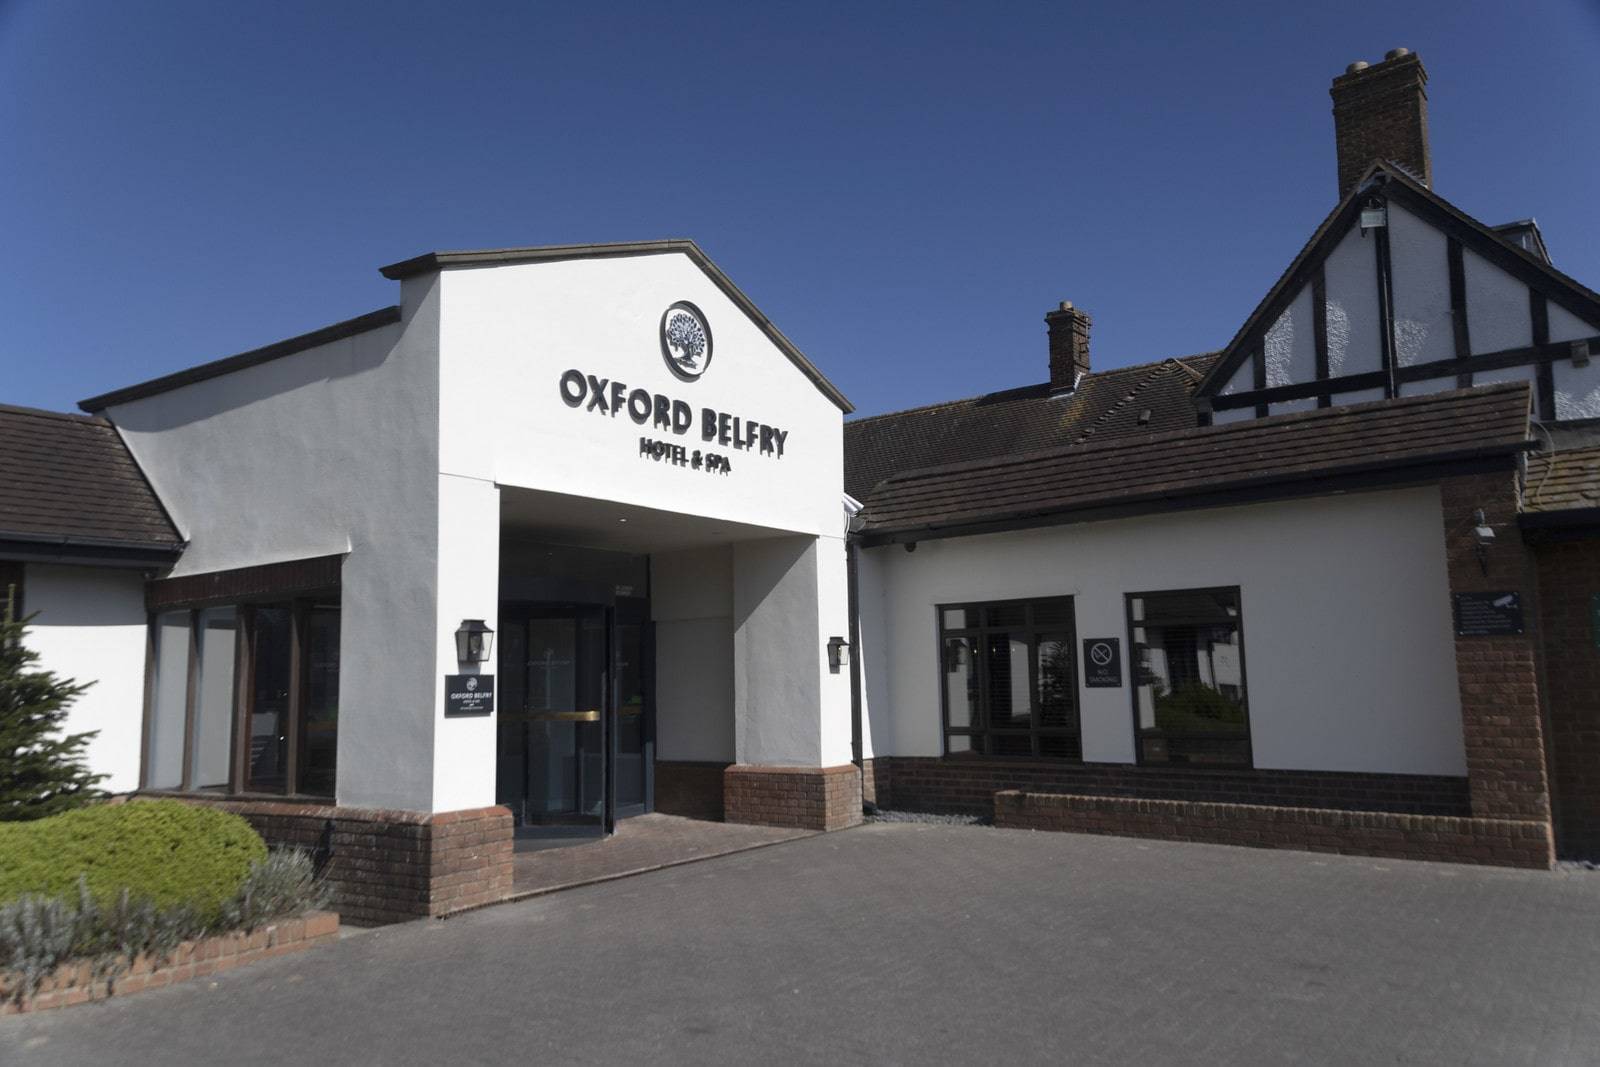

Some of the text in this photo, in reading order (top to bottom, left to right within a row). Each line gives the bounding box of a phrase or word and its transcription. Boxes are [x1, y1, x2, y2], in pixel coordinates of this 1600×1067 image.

[560, 369, 788, 459] OXFORD BELFRY
[640, 437, 731, 476] HOTEL & SPA
[450, 692, 473, 700] OXFORD
